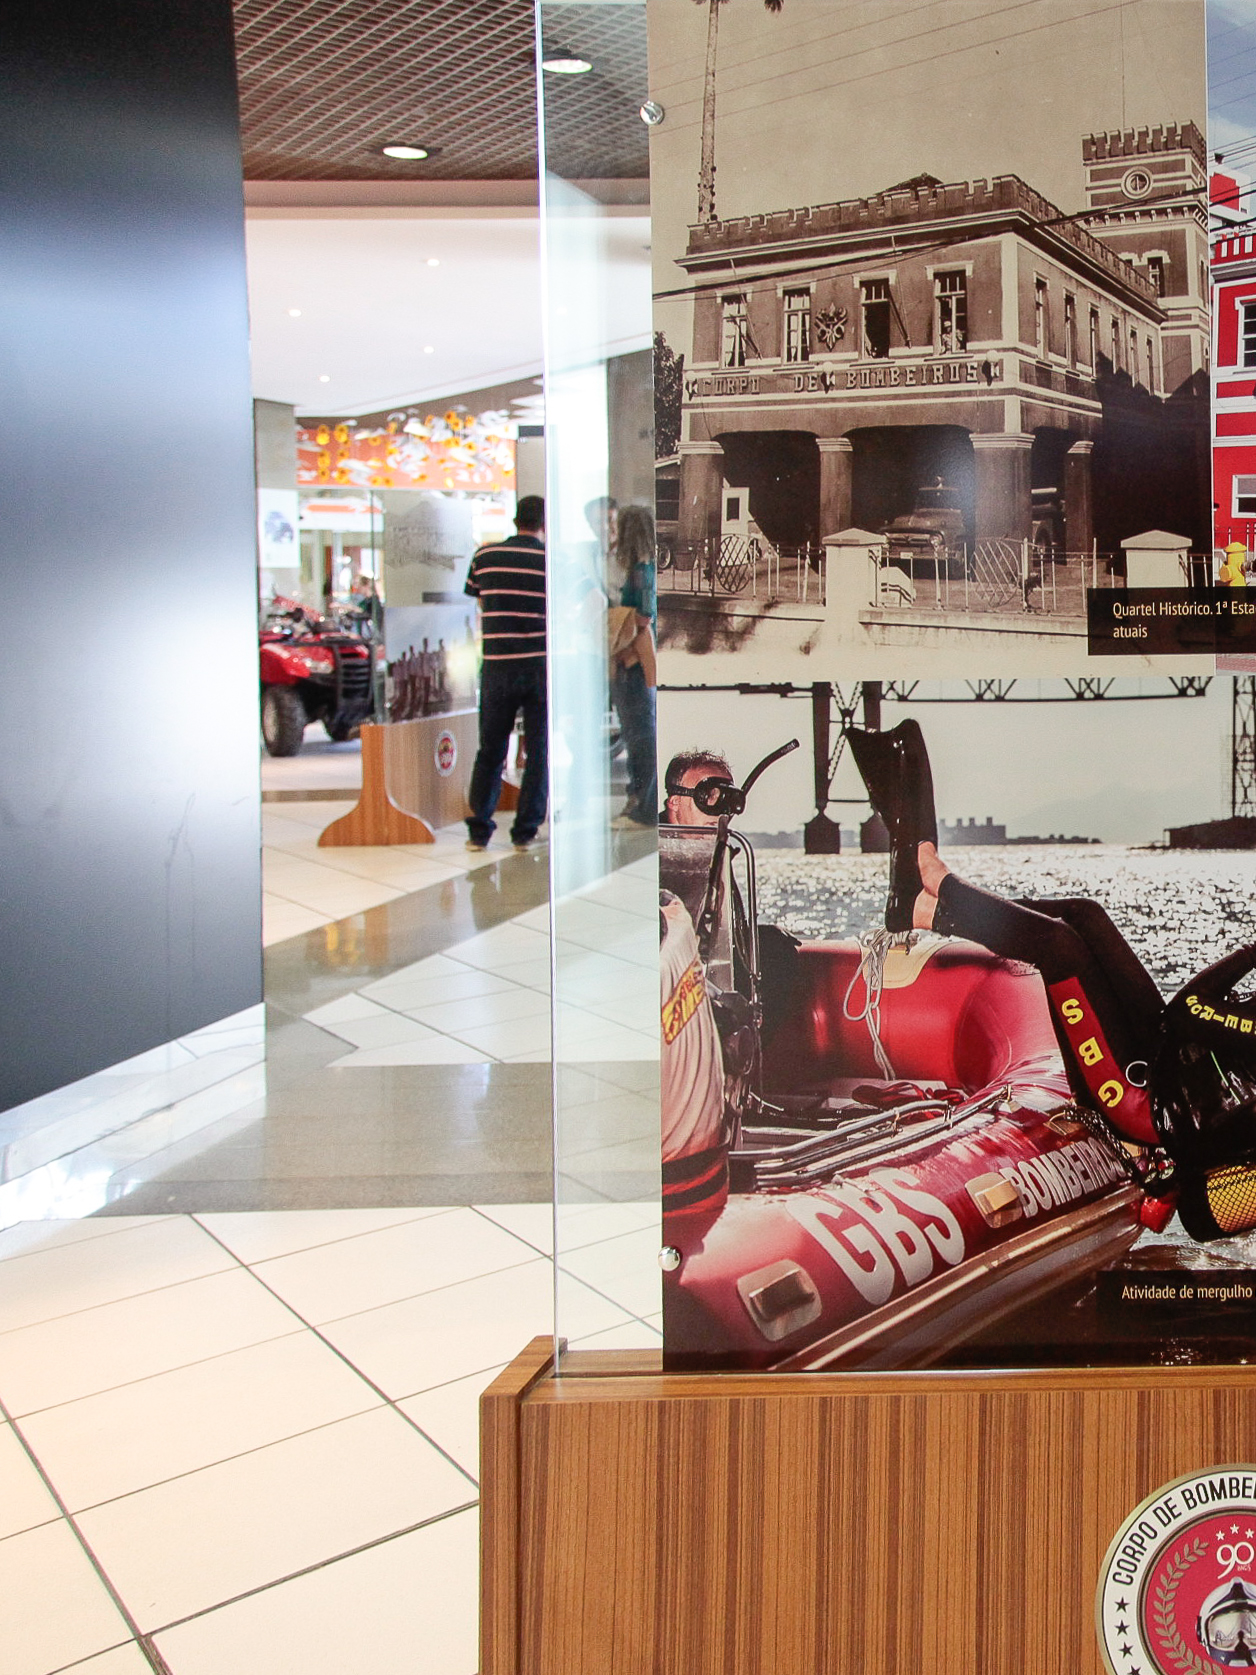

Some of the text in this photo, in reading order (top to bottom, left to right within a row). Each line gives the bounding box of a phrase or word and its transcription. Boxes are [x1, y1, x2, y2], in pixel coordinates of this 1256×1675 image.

[793, 372, 820, 394] DE
[845, 361, 979, 390] BOMBEIROS
[1113, 602, 1156, 619] Quartel
[1159, 601, 1213, 616] Histórico.
[1215, 601, 1228, 615] 1ª
[1113, 624, 1148, 638] atuais
[784, 1166, 965, 1305] GBS
[1122, 1285, 1176, 1299] Atividade
[1179, 1285, 1194, 1299] de
[1197, 1284, 1252, 1301] mergulho
[1112, 1521, 1158, 1586] CORPO
[1152, 1497, 1182, 1528] DE
[1216, 1541, 1255, 1579] 90
